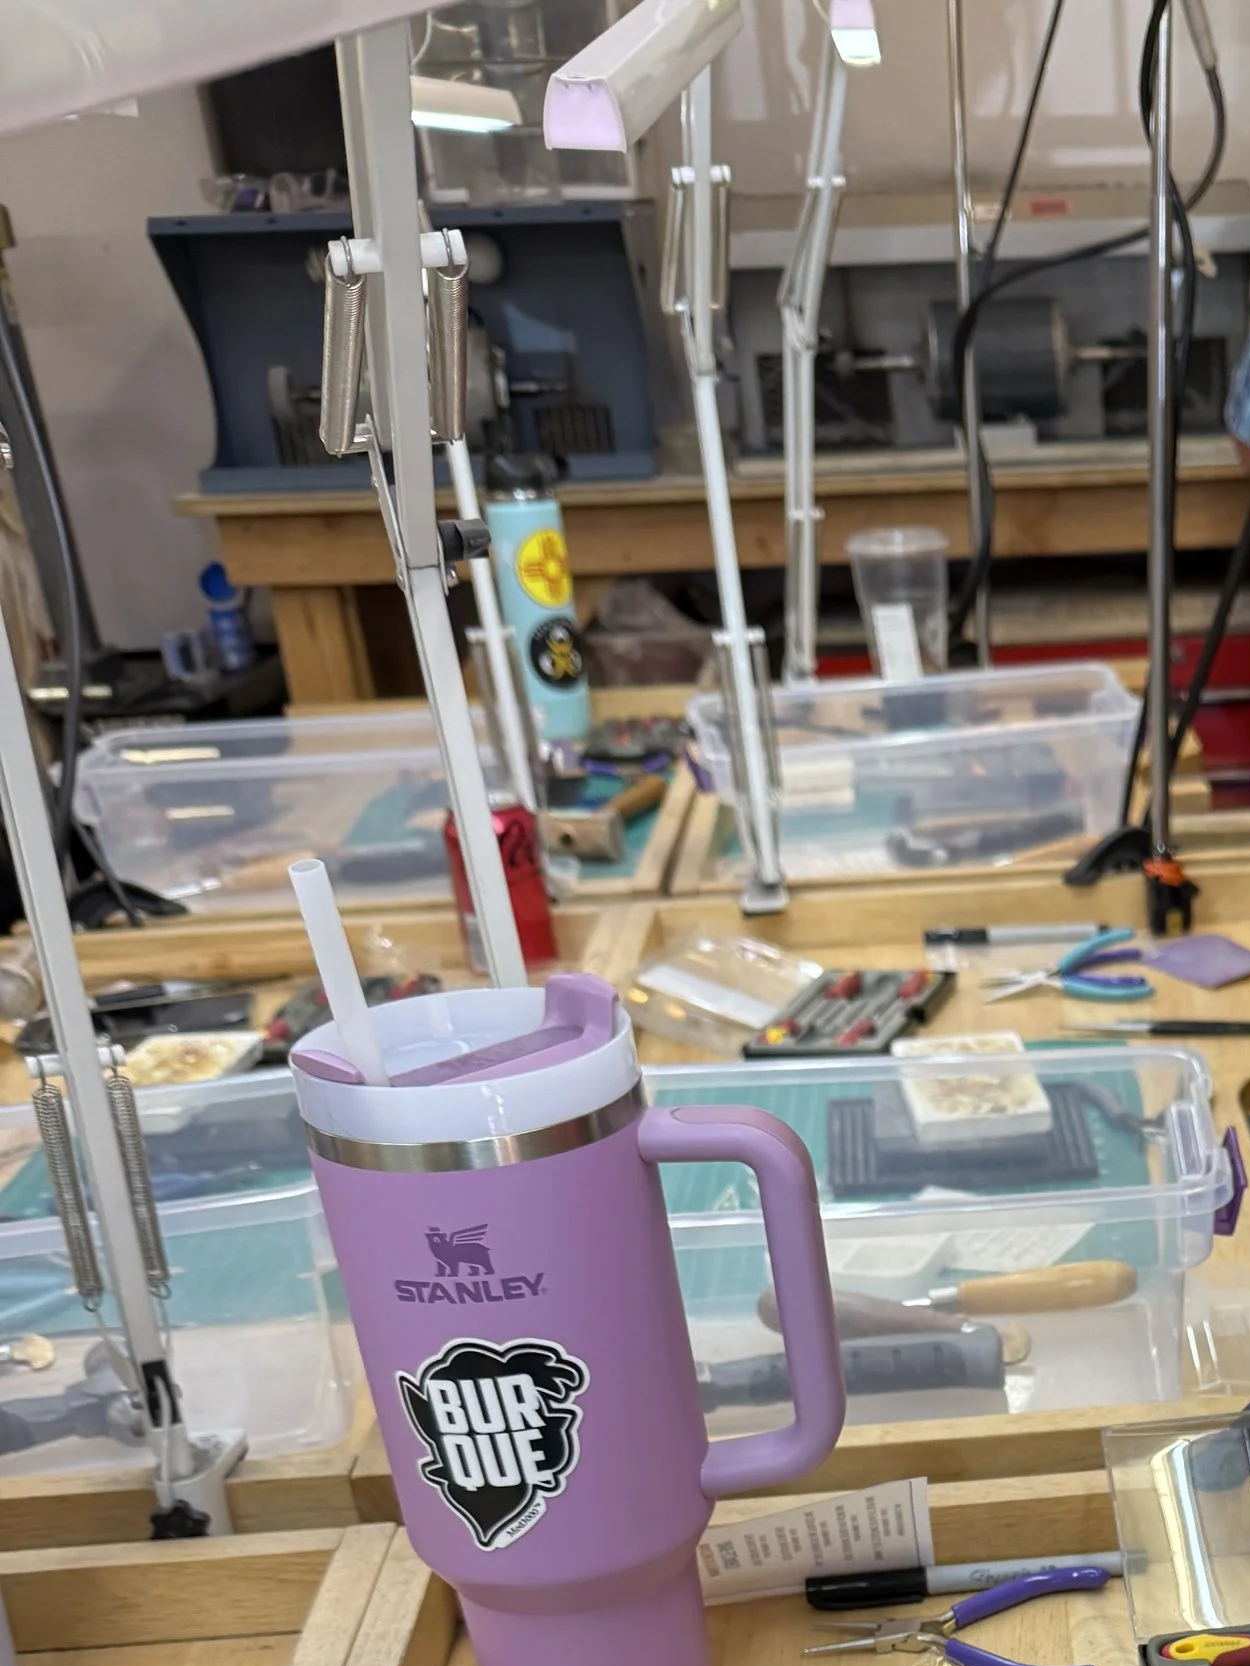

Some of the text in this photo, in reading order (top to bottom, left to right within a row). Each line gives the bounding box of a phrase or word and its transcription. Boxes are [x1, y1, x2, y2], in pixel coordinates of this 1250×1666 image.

[394, 1272, 546, 1304] STANLEY
[425, 1372, 547, 1434] BUR
[442, 1428, 552, 1491] QUE
